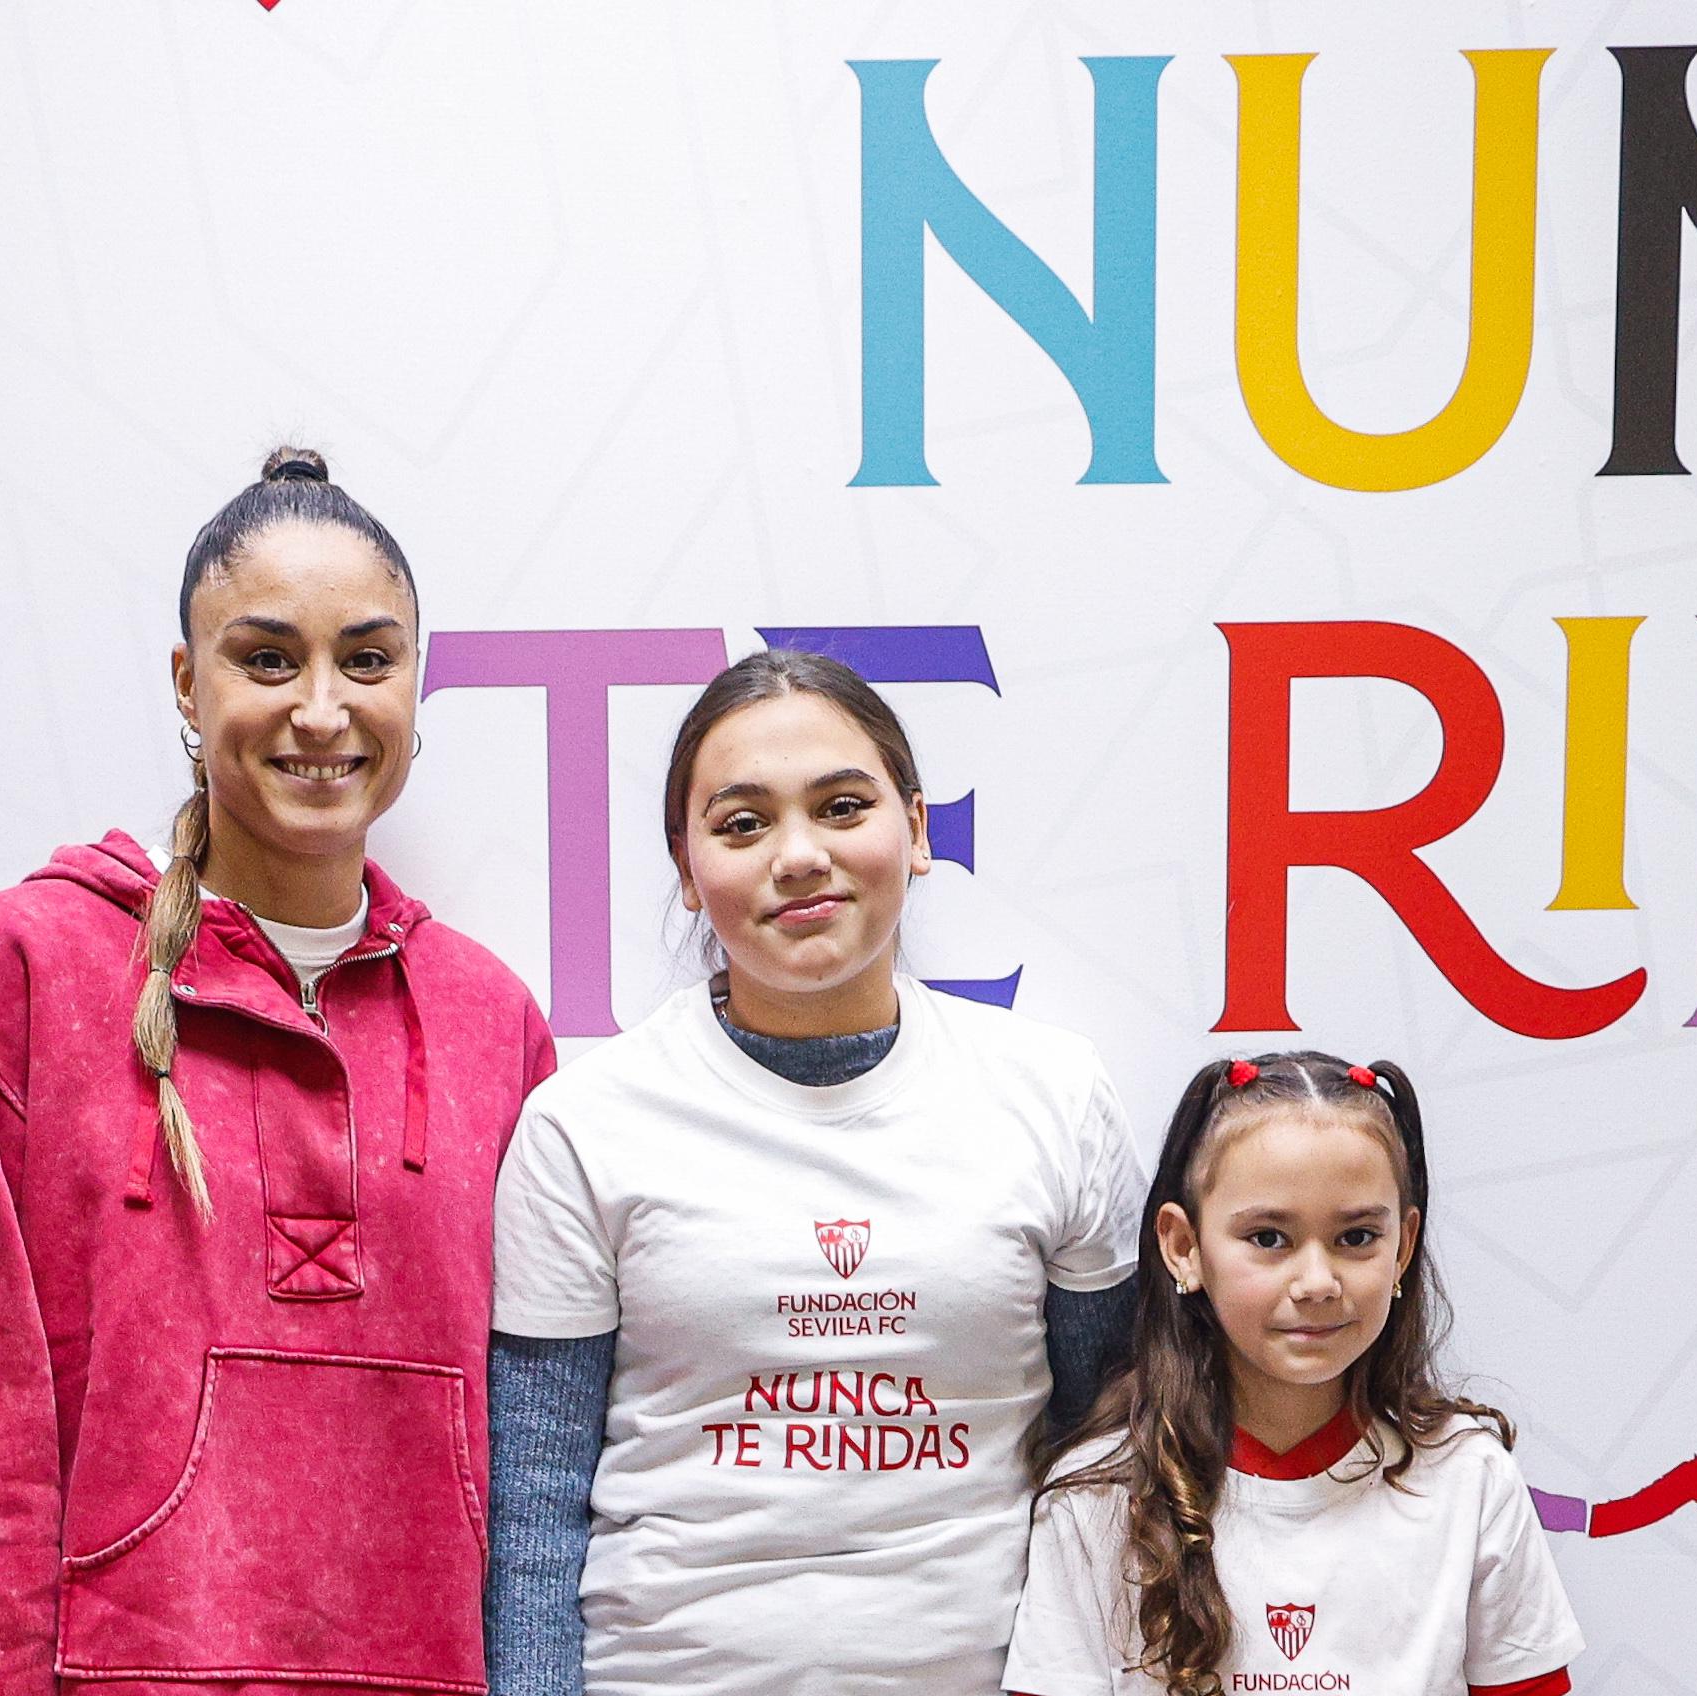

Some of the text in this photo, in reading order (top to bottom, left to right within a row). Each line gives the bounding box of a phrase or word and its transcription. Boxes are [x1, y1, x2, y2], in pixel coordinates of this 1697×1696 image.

[777, 1289, 917, 1314] FUNDACIÓN
[788, 1316, 906, 1338] SEVILLA FC
[745, 1370, 938, 1417] NUNCA
[702, 1422, 970, 1471] TE RINDAS
[1232, 1669, 1351, 1692] FUNDACIÓN
